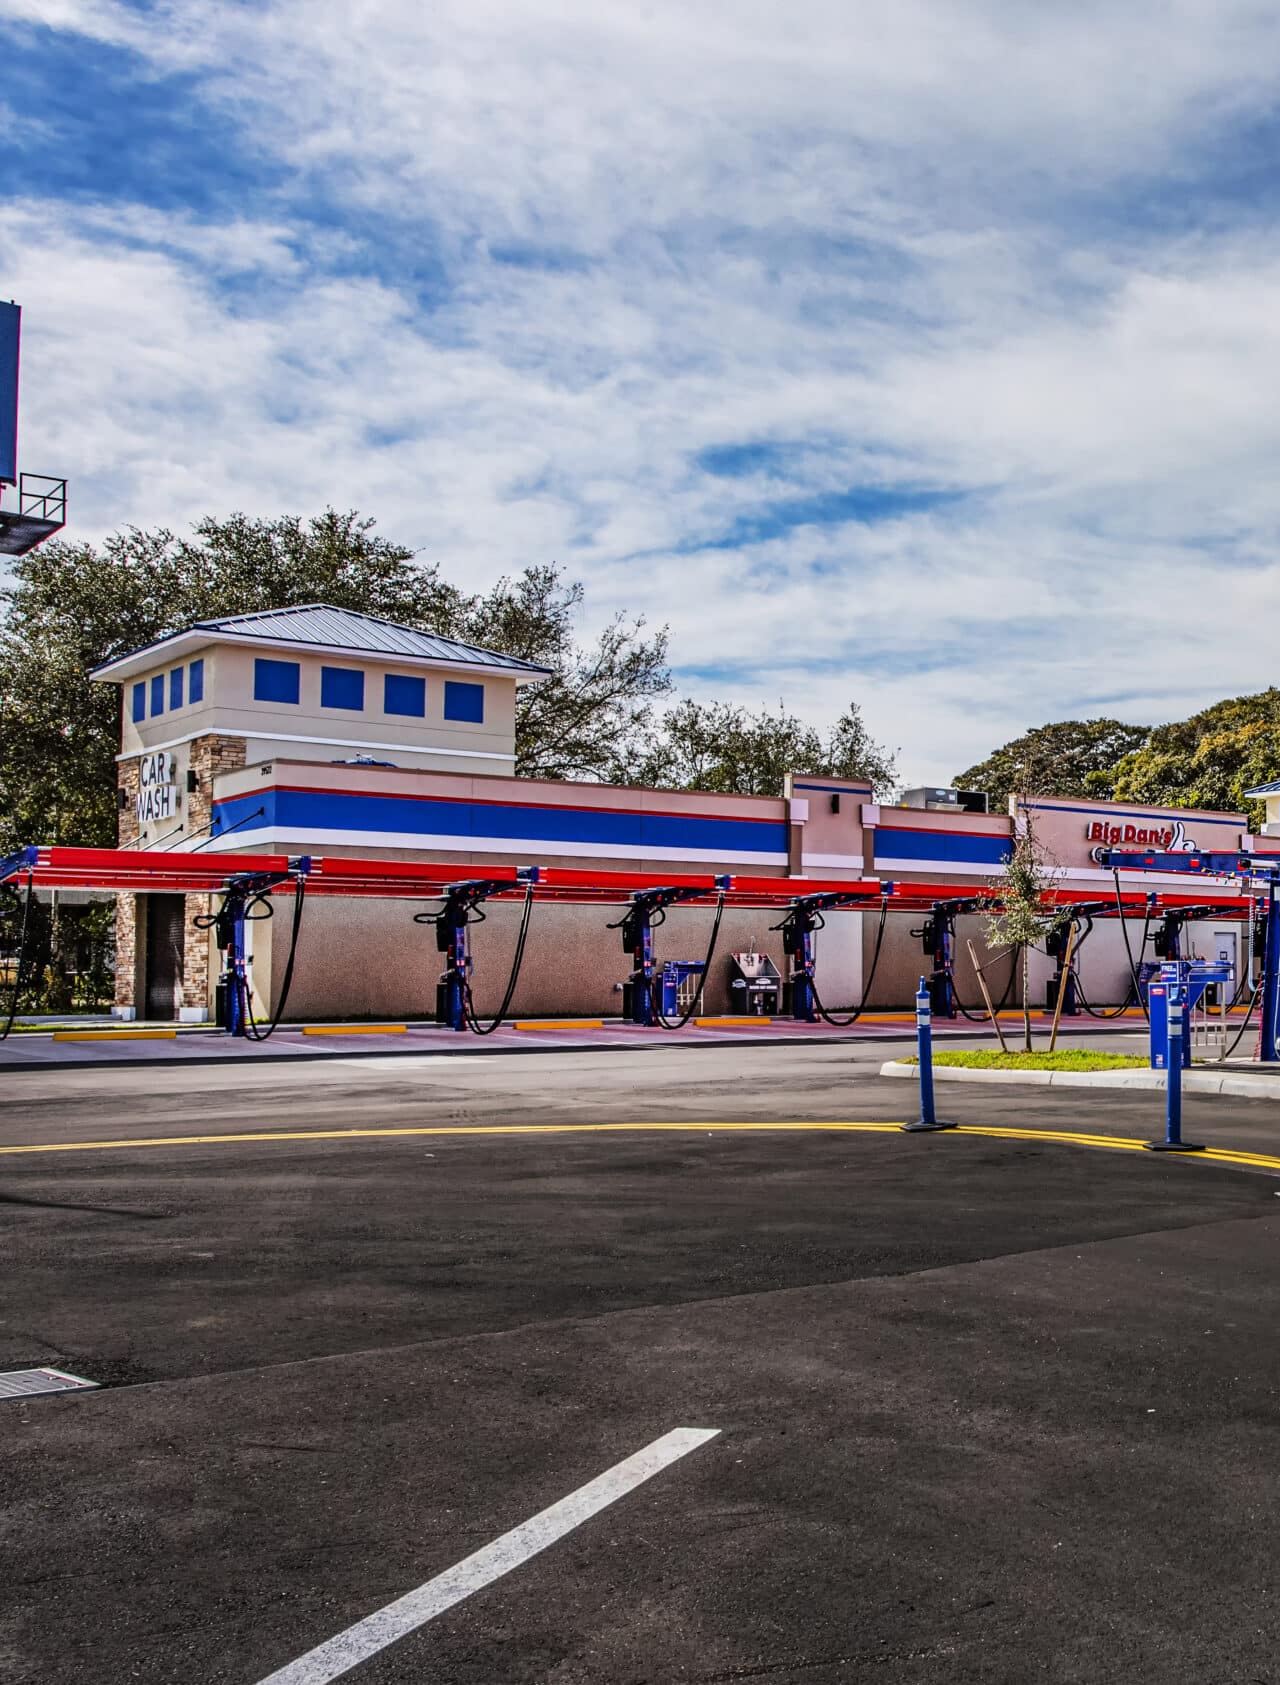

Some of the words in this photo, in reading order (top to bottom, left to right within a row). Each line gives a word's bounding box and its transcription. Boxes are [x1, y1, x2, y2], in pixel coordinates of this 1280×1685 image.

[141, 753, 166, 787] CAR
[136, 787, 171, 821] WASH
[1089, 822, 1121, 845] Big
[1123, 824, 1172, 844] Dan's
